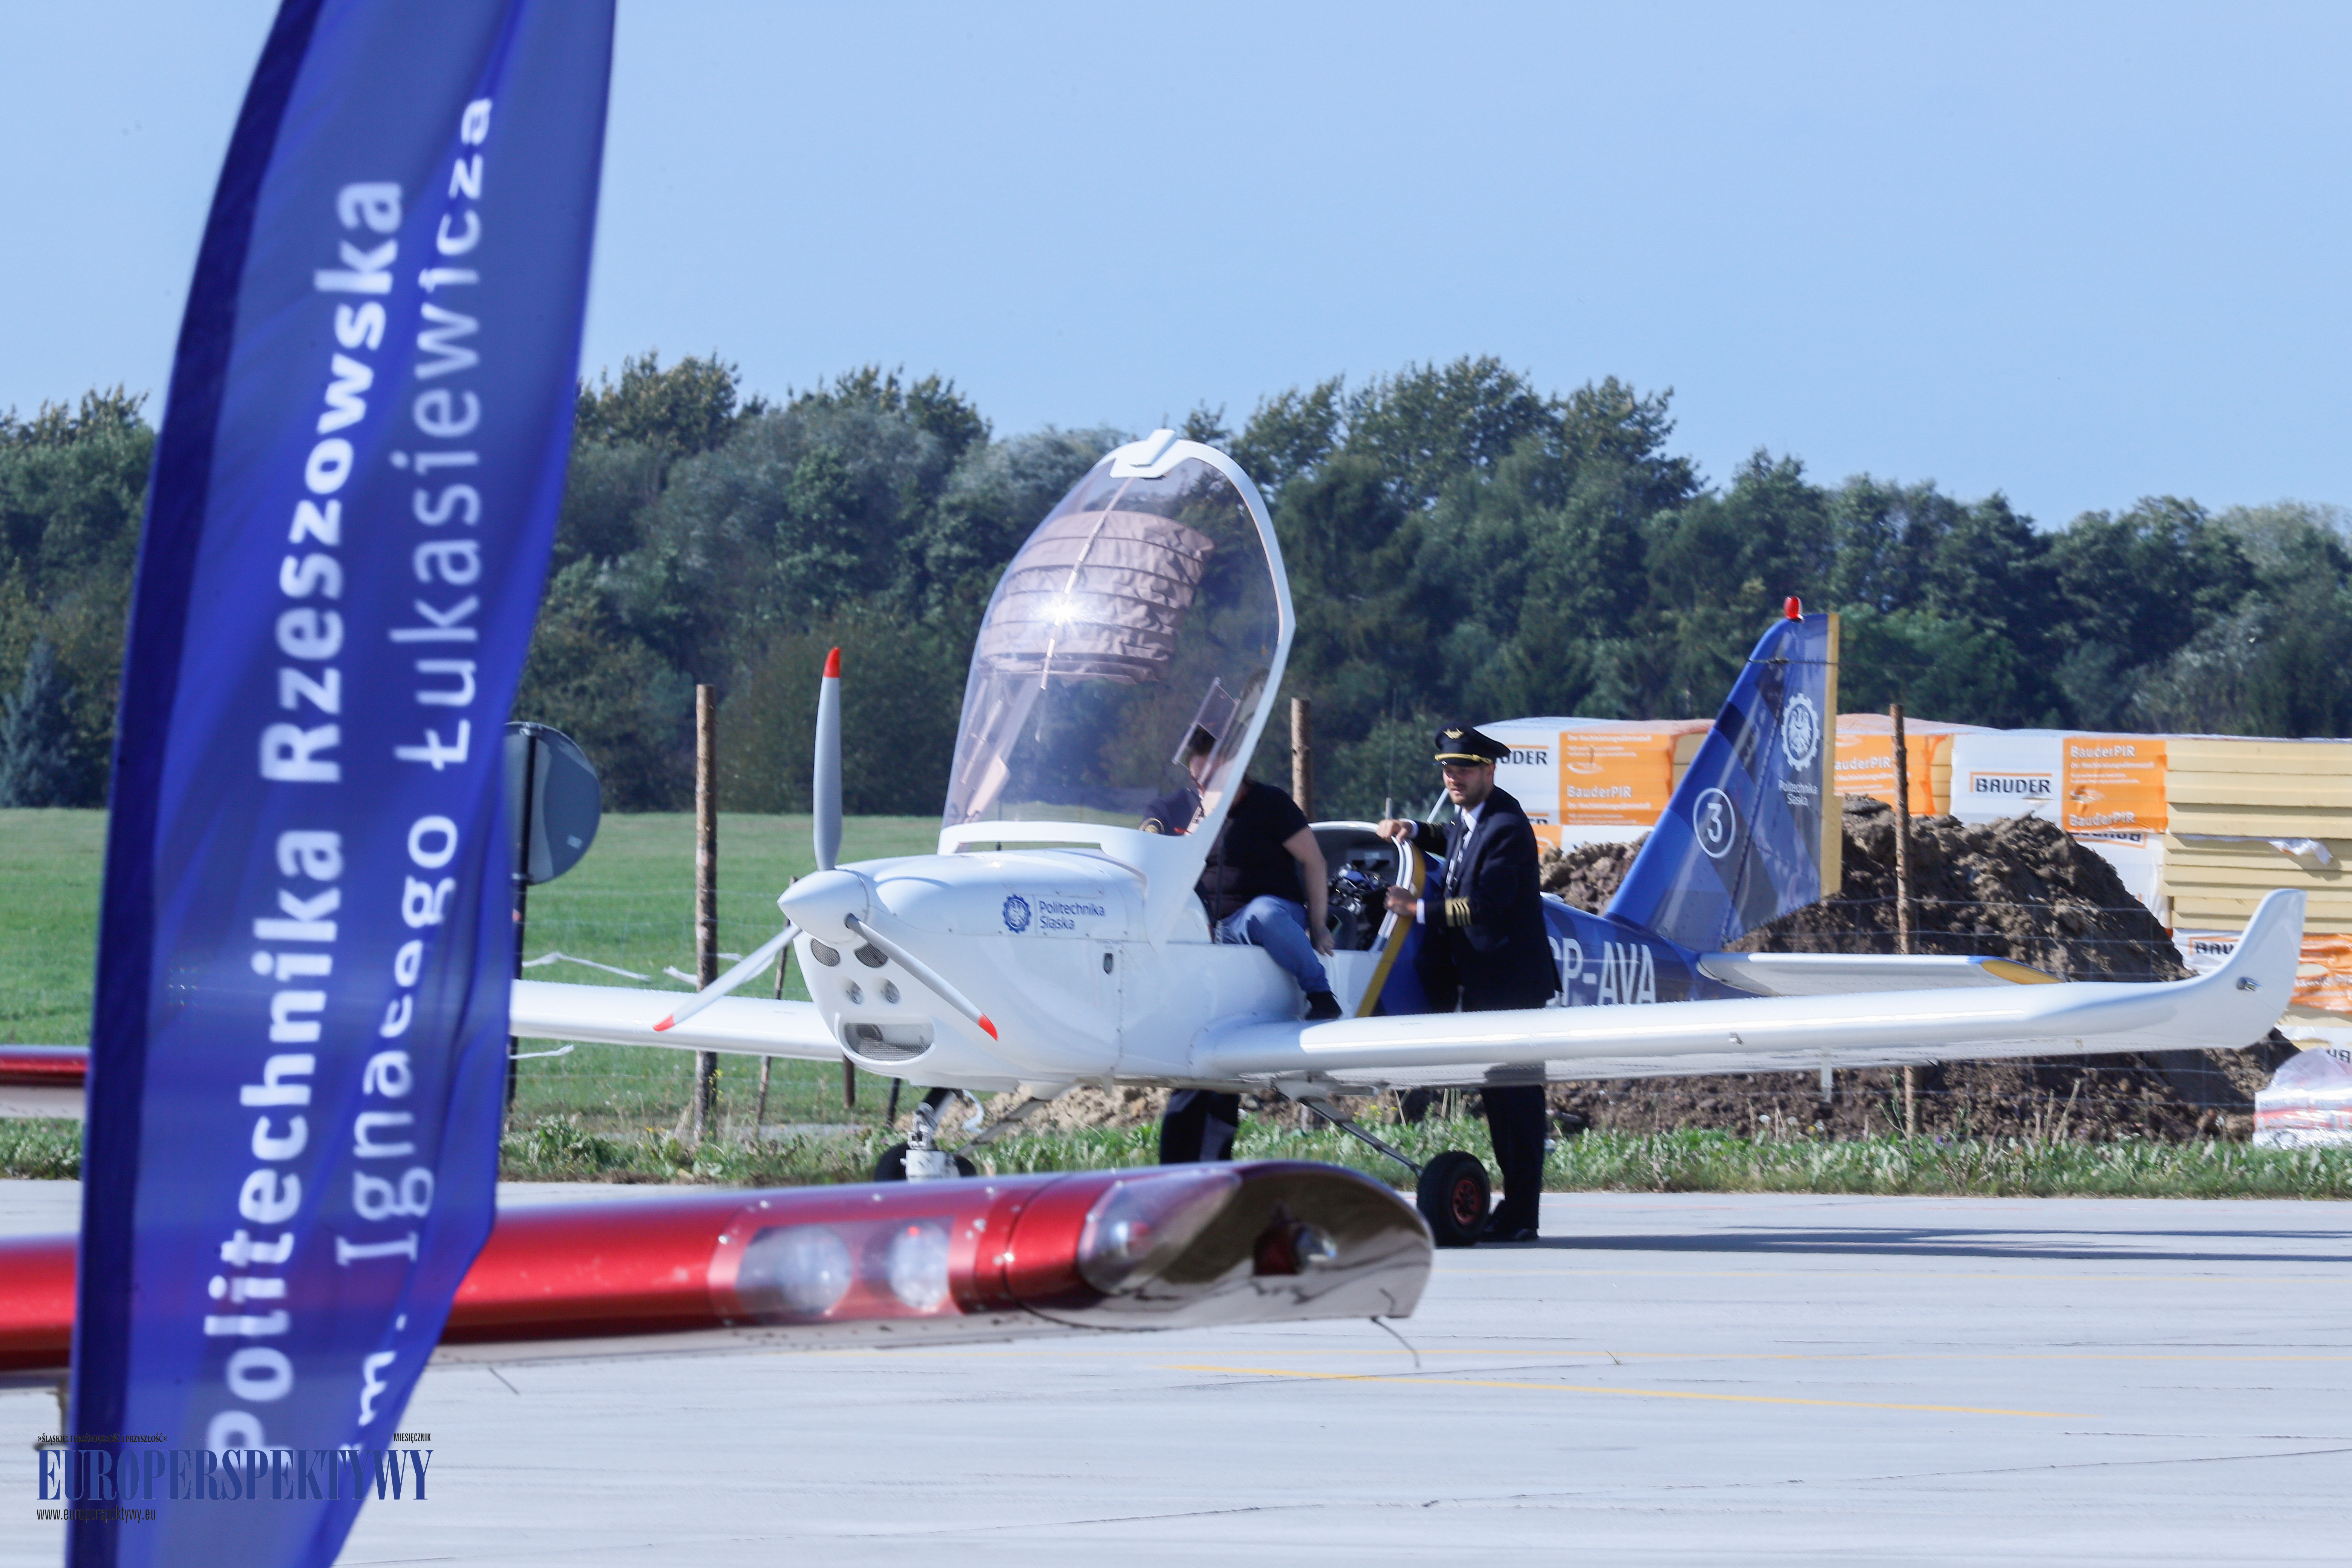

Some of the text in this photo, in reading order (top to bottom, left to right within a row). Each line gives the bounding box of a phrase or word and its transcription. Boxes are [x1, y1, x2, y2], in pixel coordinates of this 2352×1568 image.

[388, 96, 492, 770] Łukasiewicza
[2070, 744, 2136, 759] BauderPIR
[1834, 756, 1891, 771] auderPIR
[1567, 785, 1632, 798] BauderPIR
[1778, 779, 1819, 795] Politechnika
[1976, 778, 2052, 794] BAUDER
[204, 182, 403, 1468] Politechnika Rzeszowska
[1707, 803, 1723, 842] 3
[2069, 811, 2136, 827] BauderPIR
[1038, 900, 1106, 917] Politechnika
